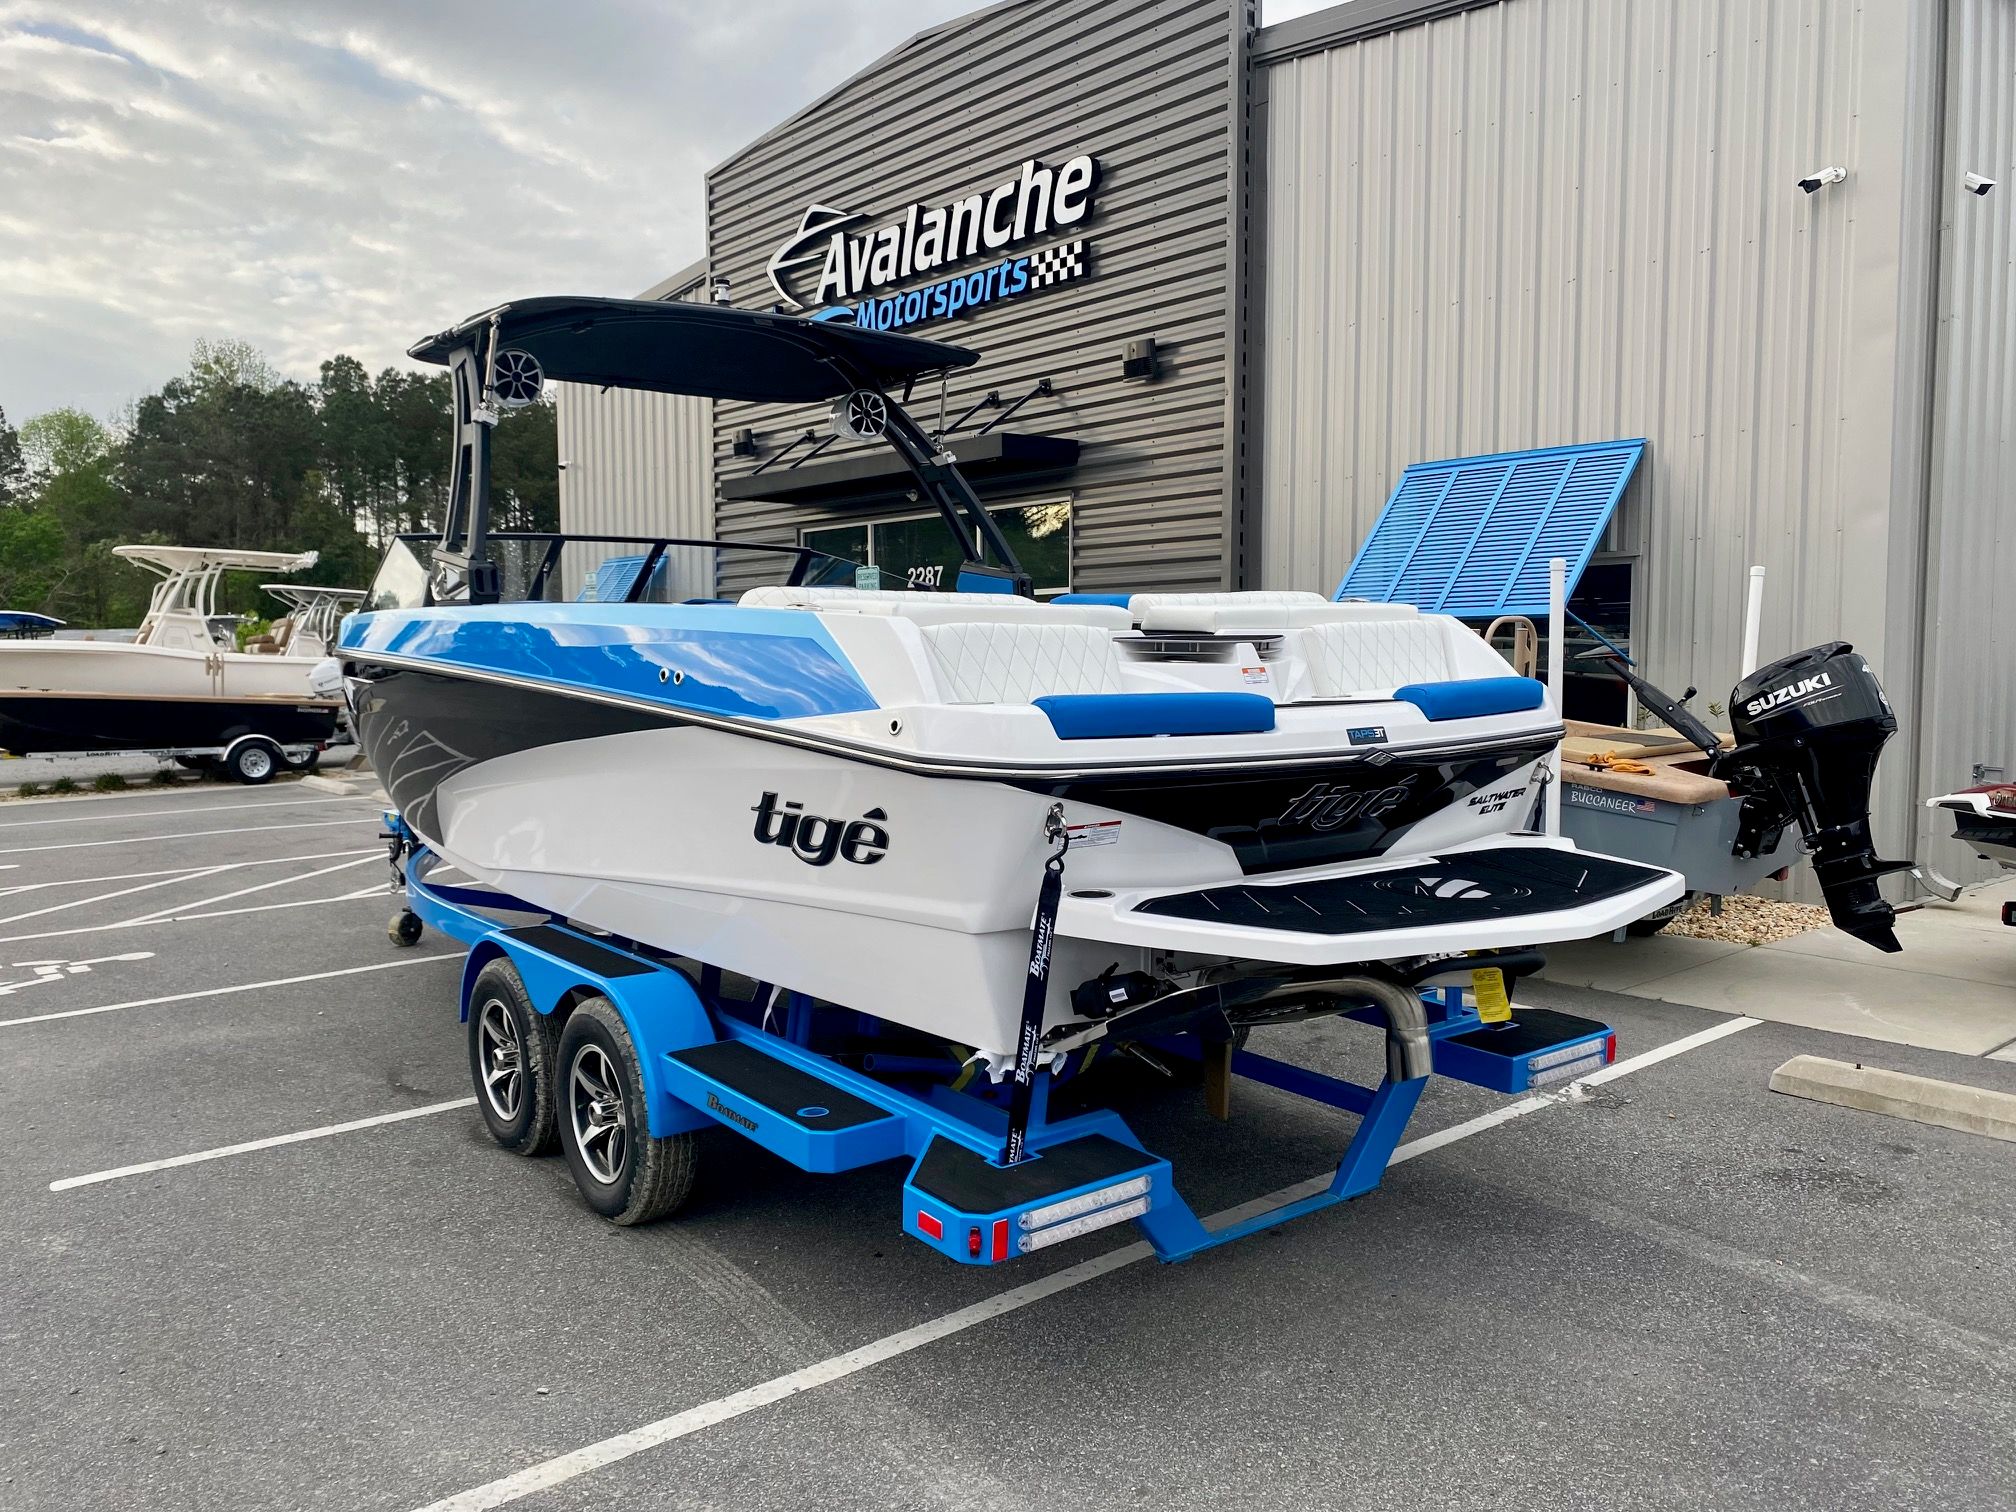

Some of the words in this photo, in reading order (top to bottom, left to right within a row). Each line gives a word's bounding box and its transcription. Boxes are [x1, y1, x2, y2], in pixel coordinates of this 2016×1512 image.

[814, 155, 1093, 305] Avalanche
[856, 258, 1029, 331] Motorsports
[907, 565, 944, 588] 2287
[1746, 672, 1832, 716] SUZUKI
[1467, 787, 1527, 807] SALTWATER
[1479, 801, 1507, 815] ELITE
[1571, 790, 1636, 813] BUCCANEER
[1009, 1131, 1018, 1164] TMATE
